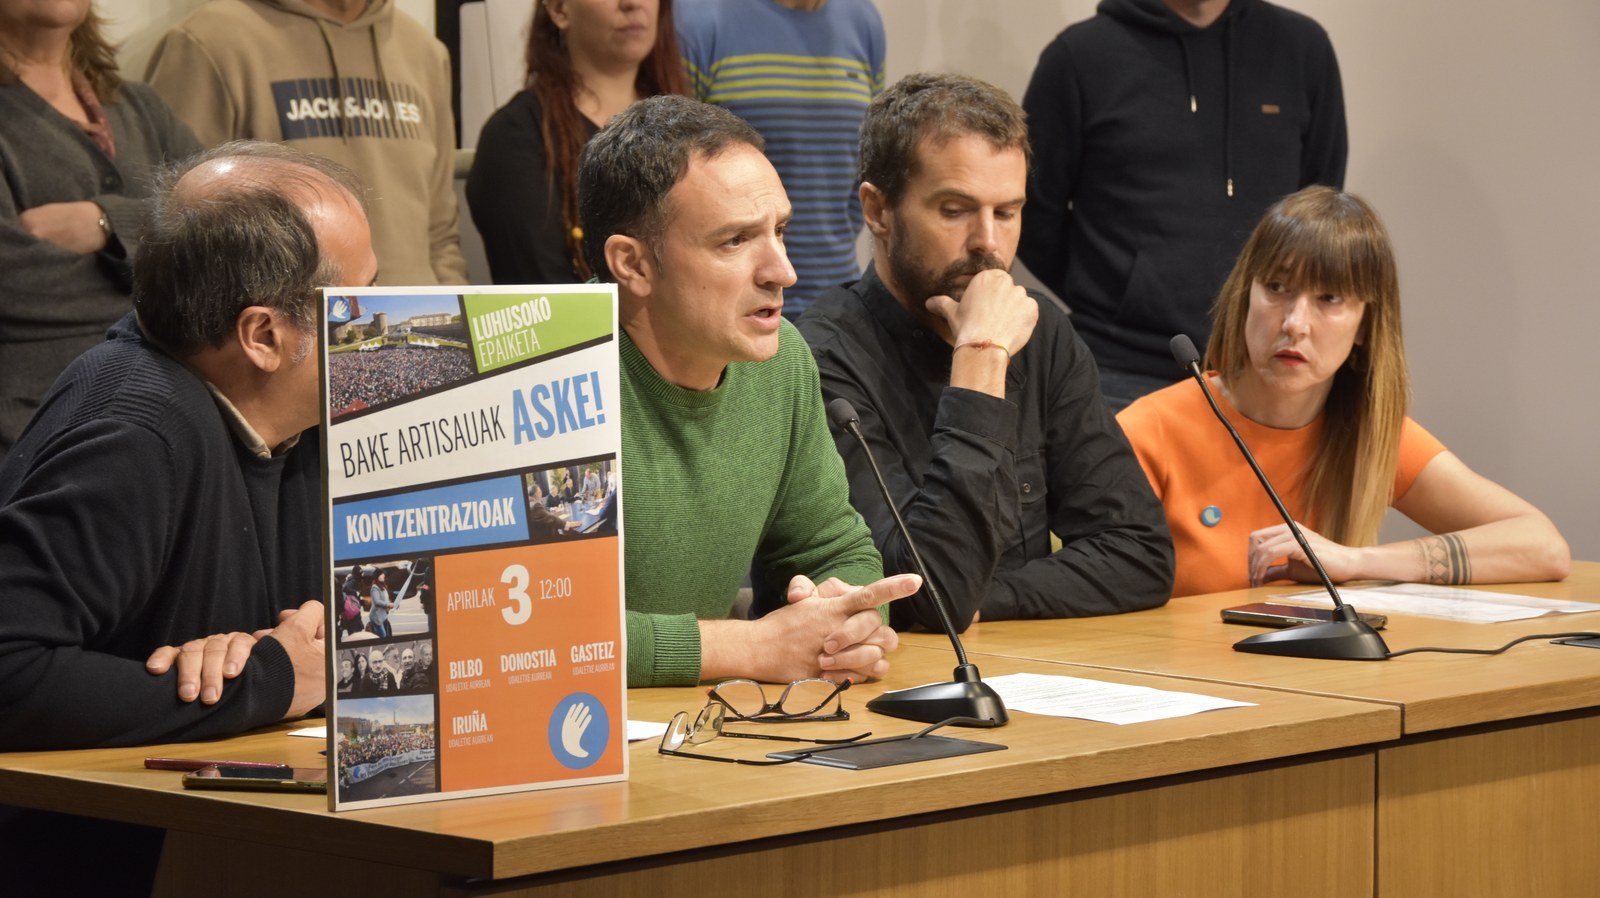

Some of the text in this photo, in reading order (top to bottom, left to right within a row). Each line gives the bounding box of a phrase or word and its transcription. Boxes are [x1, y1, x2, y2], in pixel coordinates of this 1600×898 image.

[472, 296, 552, 342] LUHUSOKO
[478, 328, 541, 368] EPAIKETA
[340, 371, 606, 478] BAKE ARTISAUAK ASKE!
[346, 497, 516, 544] KONTZENTRAZIOAK
[447, 564, 572, 625] APIRILAK 3 12:00
[450, 658, 483, 680] BILBO
[500, 649, 557, 673] DONOSTIA
[570, 641, 615, 663] GASTEIZ
[452, 710, 488, 735] IRUÑA
